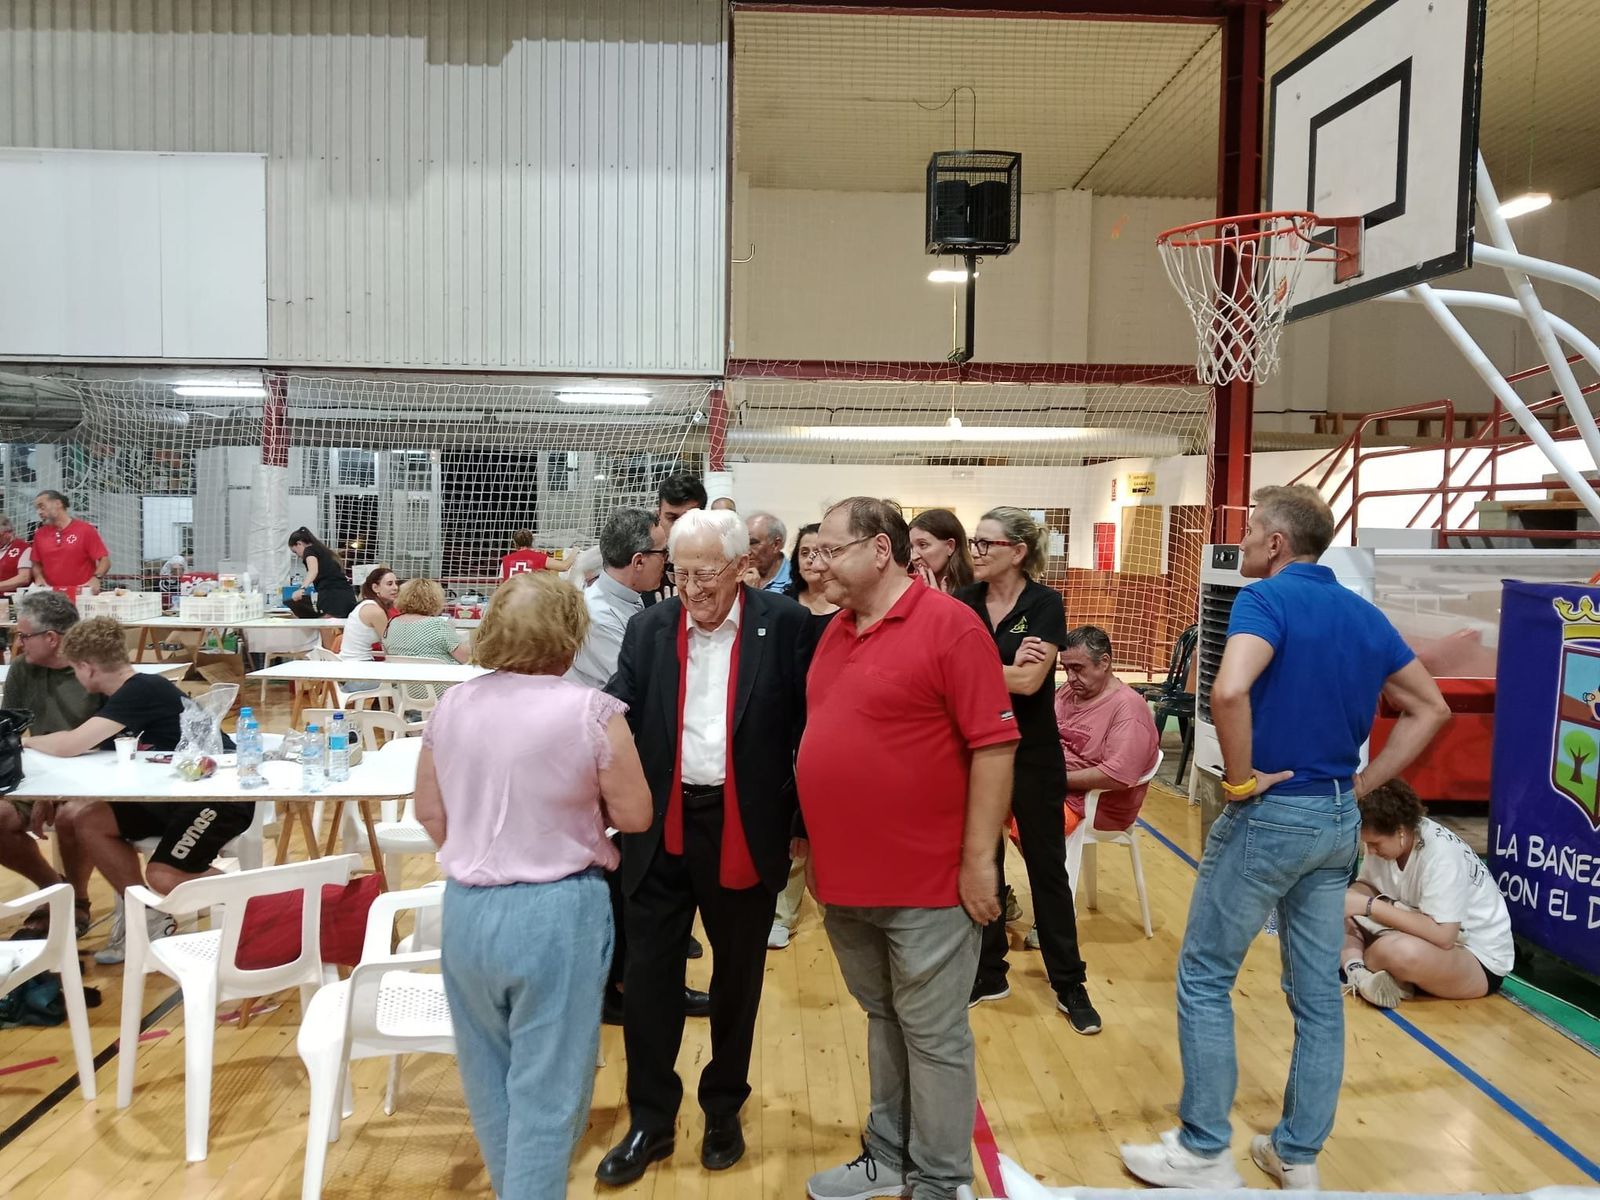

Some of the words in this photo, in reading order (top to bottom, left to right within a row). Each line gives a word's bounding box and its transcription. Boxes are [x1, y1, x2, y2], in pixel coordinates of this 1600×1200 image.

[171, 808, 217, 859] SQUAD
[1496, 825, 1518, 862] LA
[1498, 871, 1539, 910] CON
[1548, 888, 1577, 921] EL
